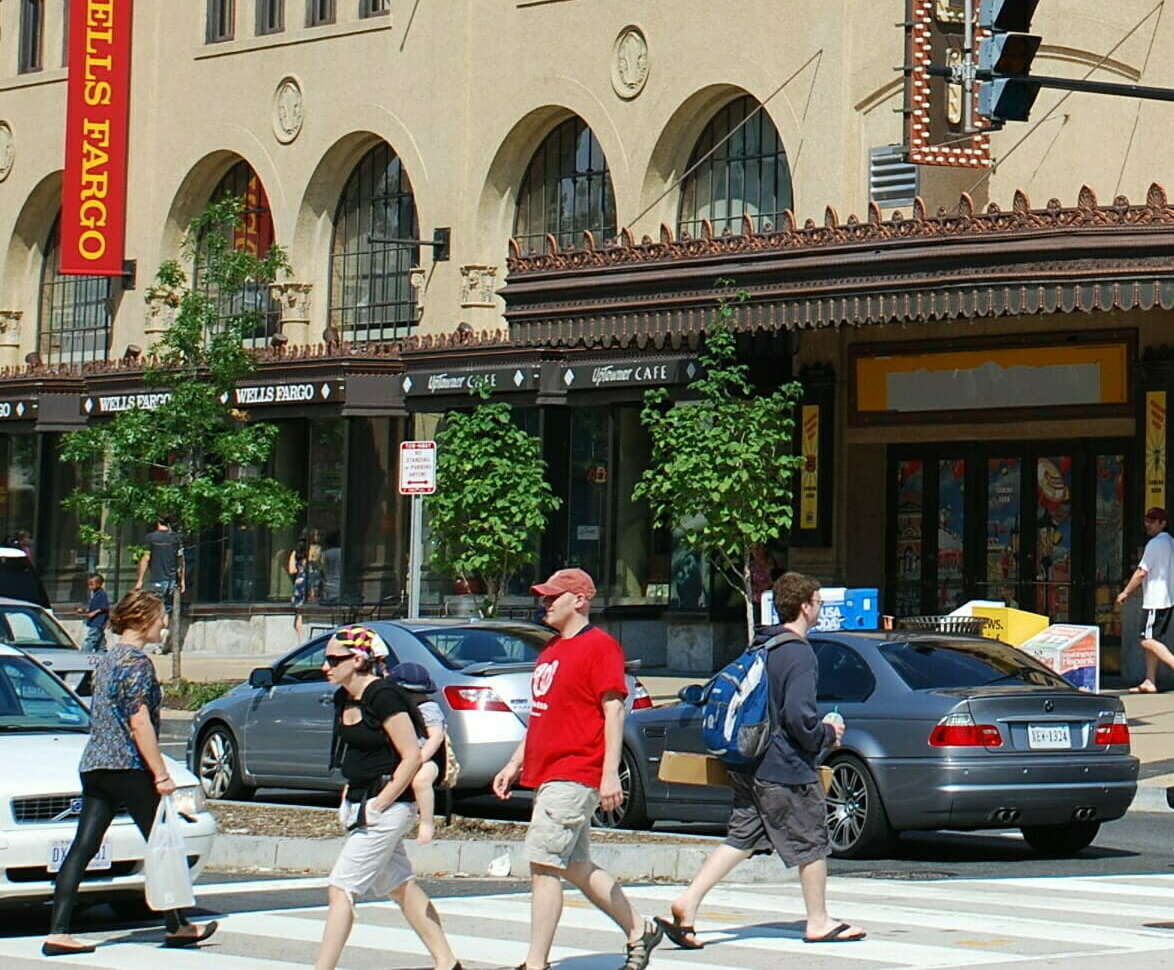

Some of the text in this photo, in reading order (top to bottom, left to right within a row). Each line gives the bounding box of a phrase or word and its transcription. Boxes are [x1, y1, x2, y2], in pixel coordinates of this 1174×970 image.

[79, 119, 110, 261] FARGO
[635, 365, 667, 381] CAFE
[236, 384, 315, 404] WELLS FARGO
[99, 395, 135, 412] WELLS
[820, 606, 842, 619] USA
